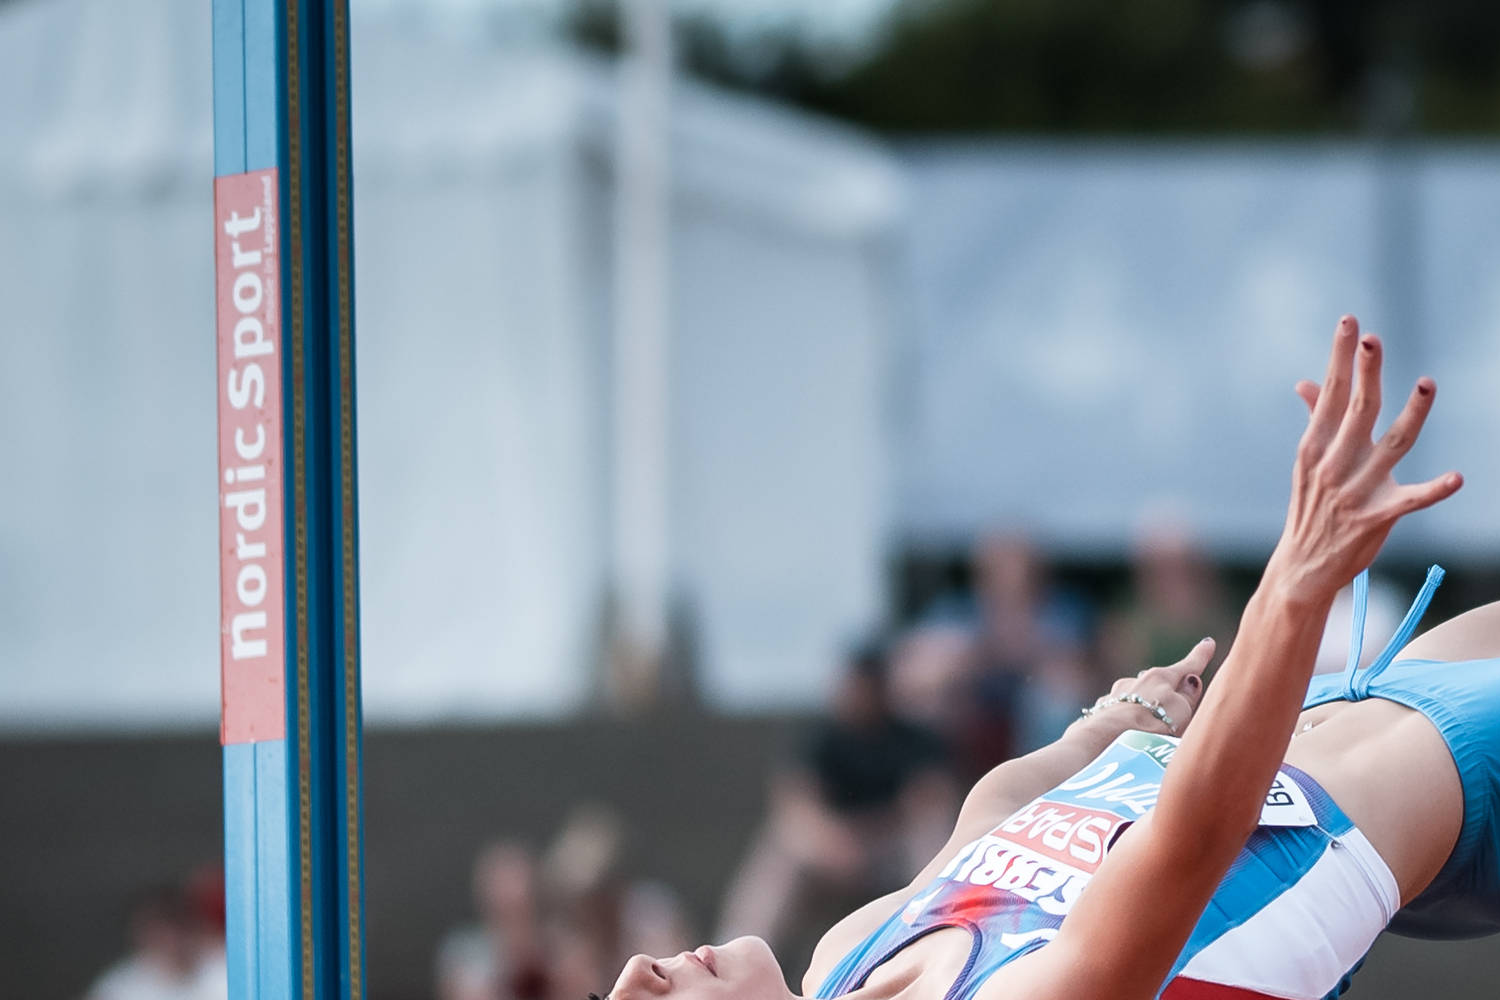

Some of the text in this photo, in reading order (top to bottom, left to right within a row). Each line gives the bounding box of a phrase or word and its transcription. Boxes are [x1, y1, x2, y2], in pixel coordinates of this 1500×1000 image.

[224, 206, 275, 661] nordic Sport
[1002, 804, 1112, 864] SPAR
